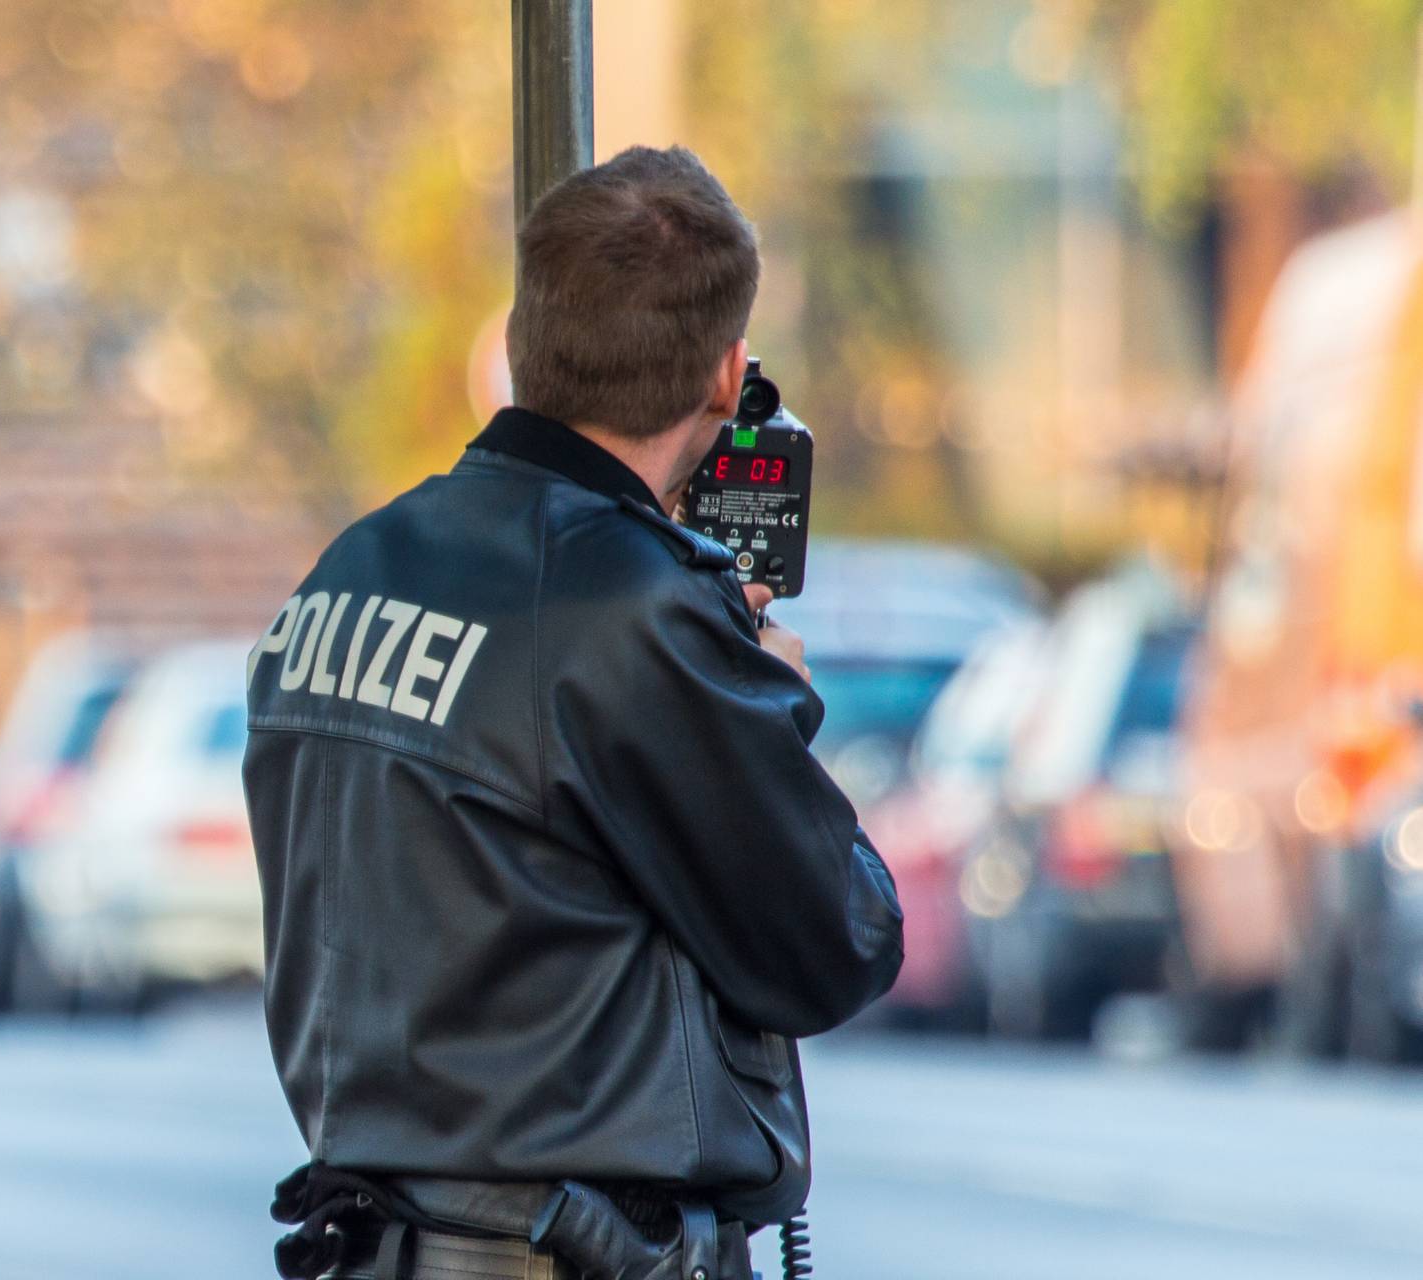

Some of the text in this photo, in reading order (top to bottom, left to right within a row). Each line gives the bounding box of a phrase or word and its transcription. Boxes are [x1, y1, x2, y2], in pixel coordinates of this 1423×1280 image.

[715, 456, 784, 482] E 03
[720, 514, 731, 523] LTI
[246, 591, 488, 727] POLIZEI
